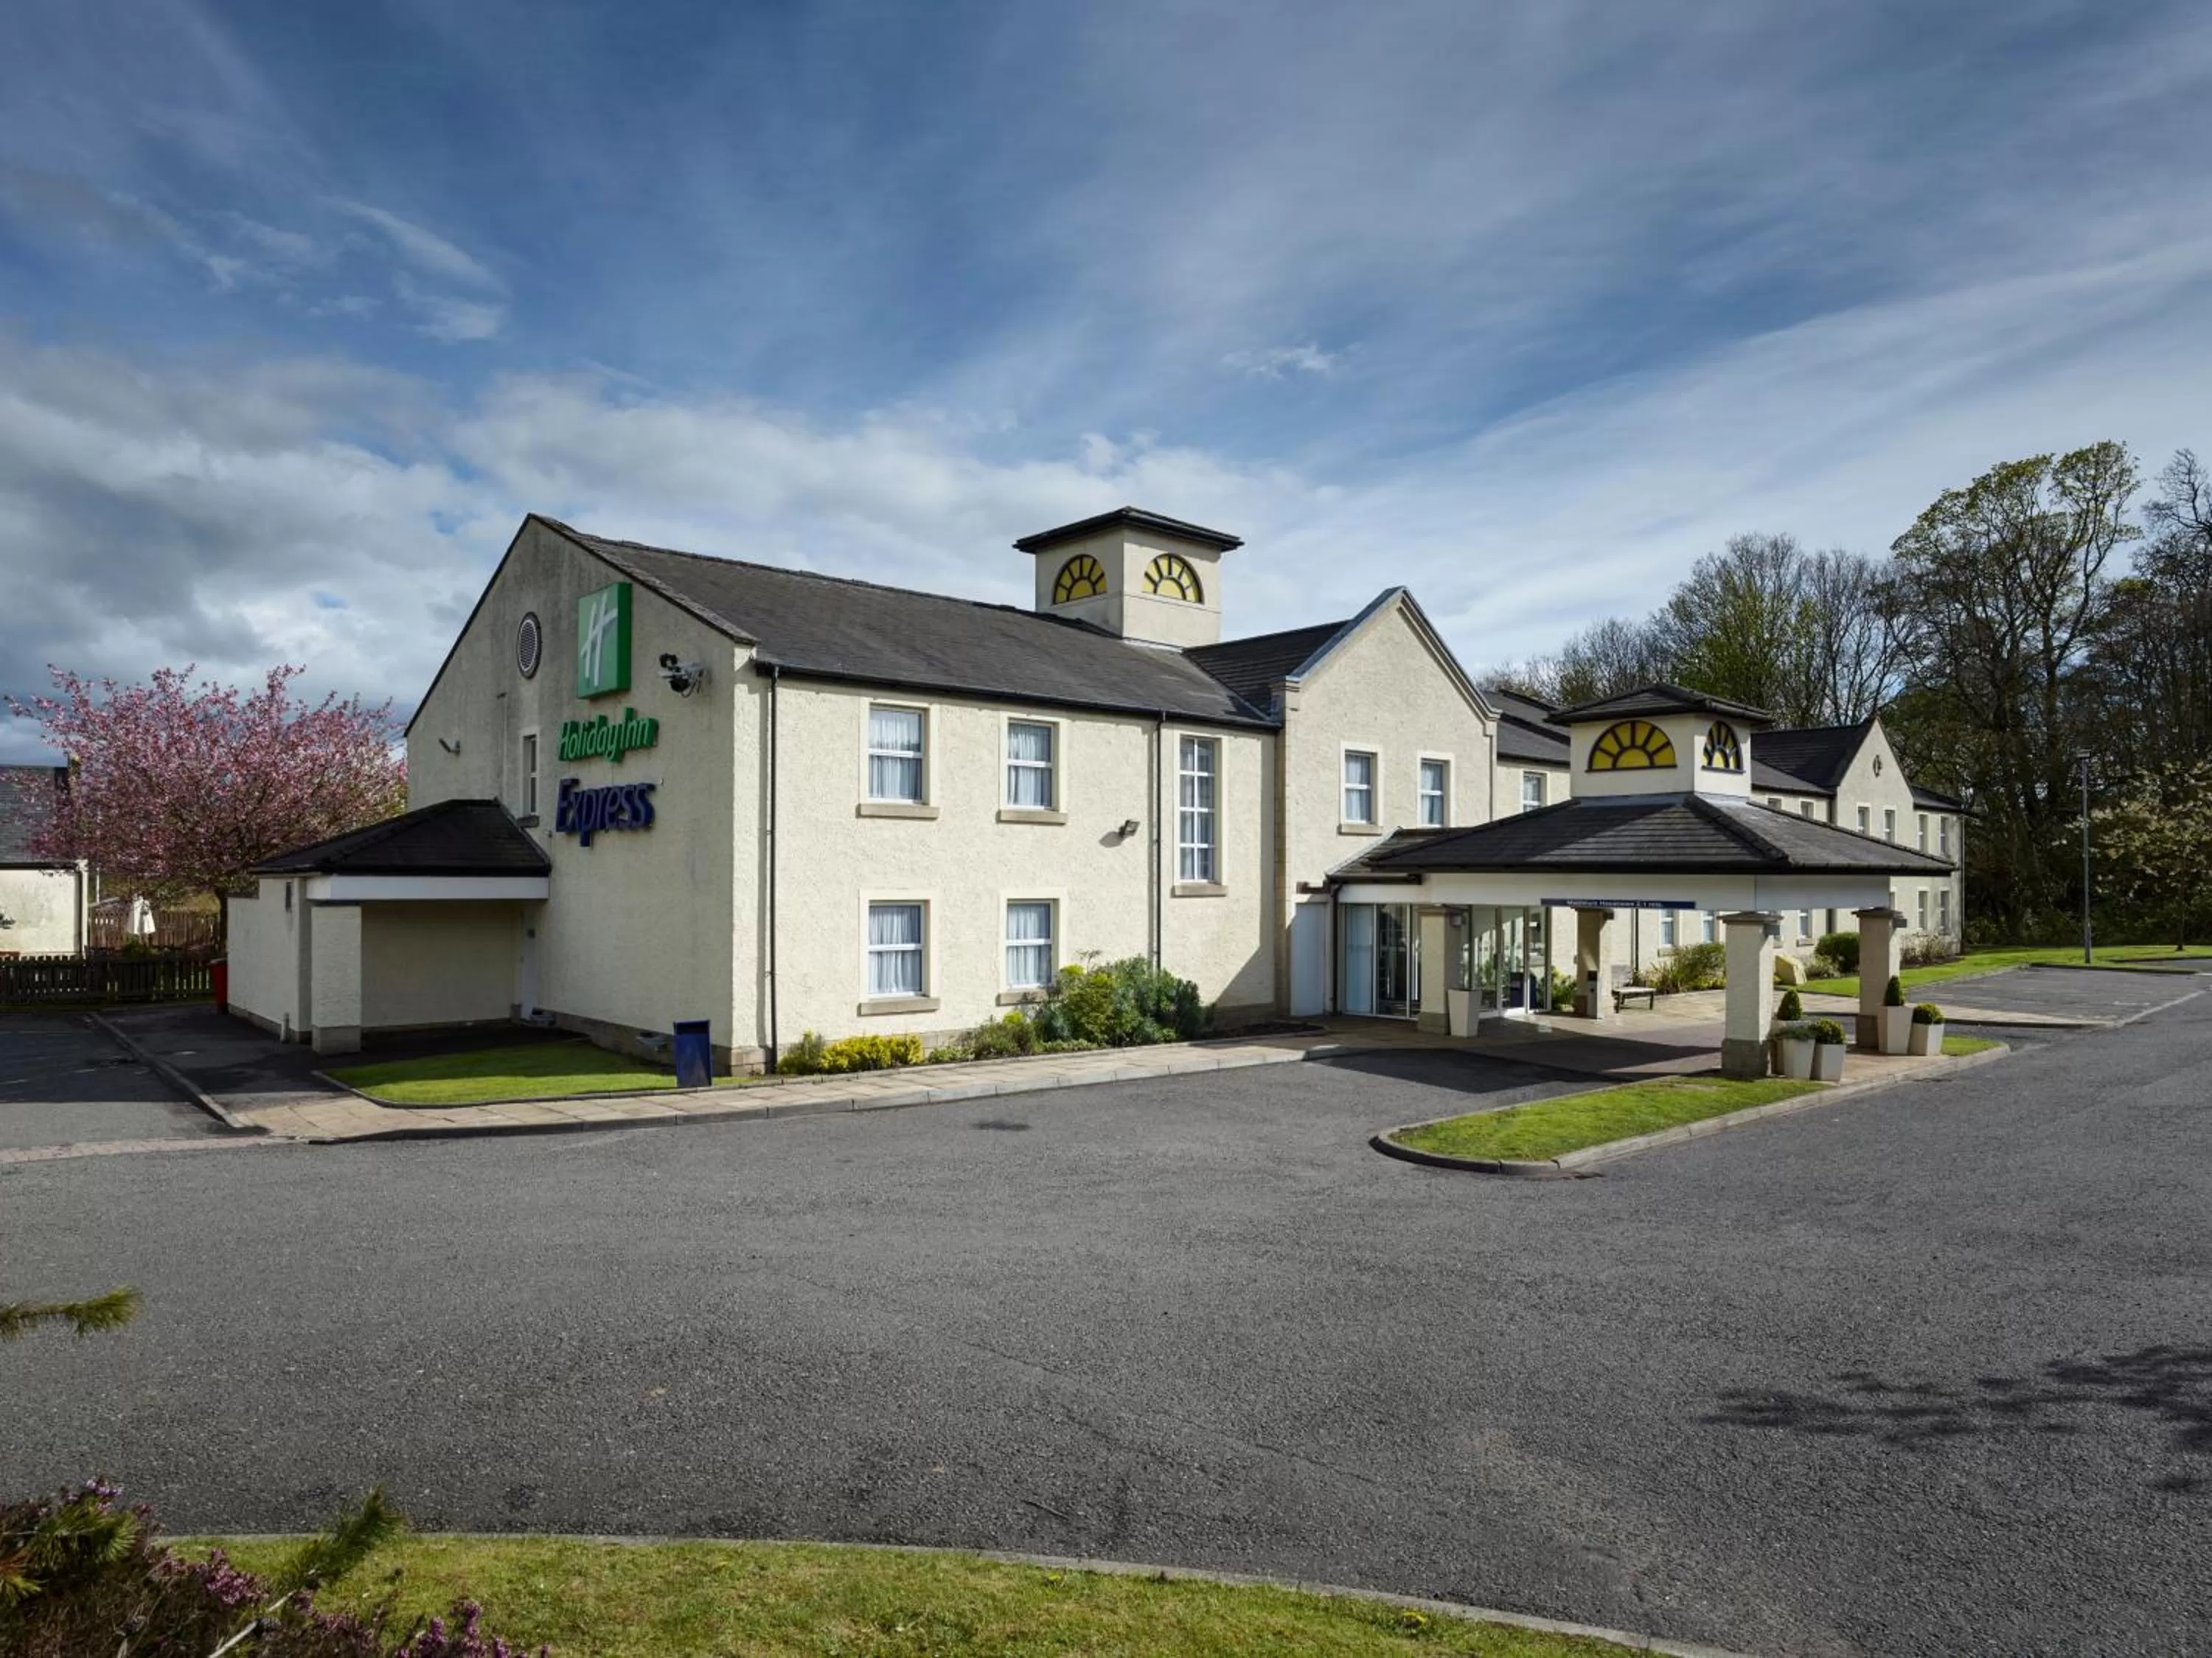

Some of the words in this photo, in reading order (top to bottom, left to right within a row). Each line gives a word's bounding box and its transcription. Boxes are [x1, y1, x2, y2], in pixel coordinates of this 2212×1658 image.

[558, 713, 622, 762] Holiday
[619, 707, 655, 749] Inn
[556, 778, 655, 847] Express
